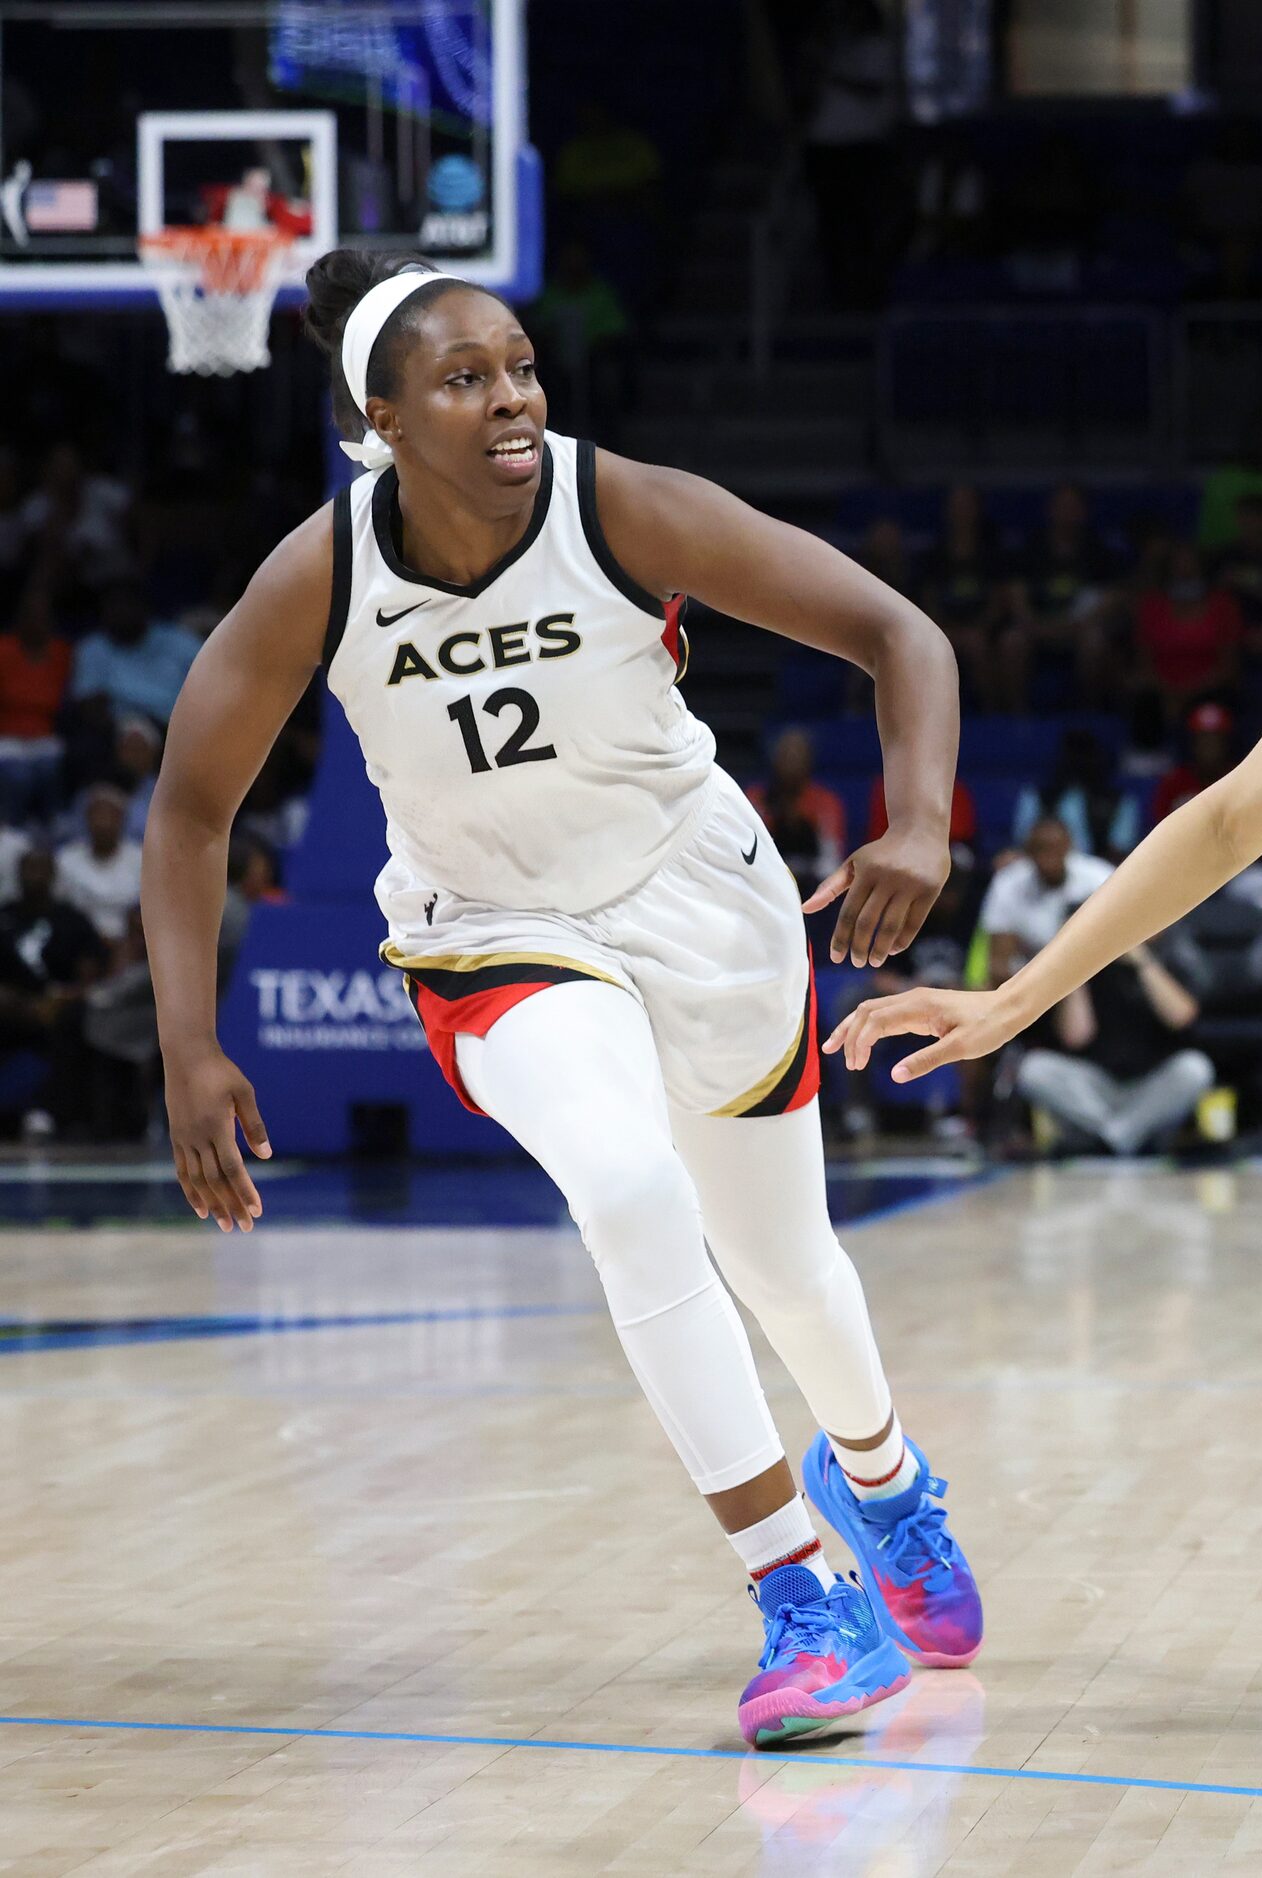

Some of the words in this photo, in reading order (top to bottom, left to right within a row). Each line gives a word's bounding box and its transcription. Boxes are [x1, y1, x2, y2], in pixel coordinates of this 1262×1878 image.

[385, 612, 582, 687] ACES
[447, 687, 557, 774] 12
[251, 969, 411, 1022] TEXAS
